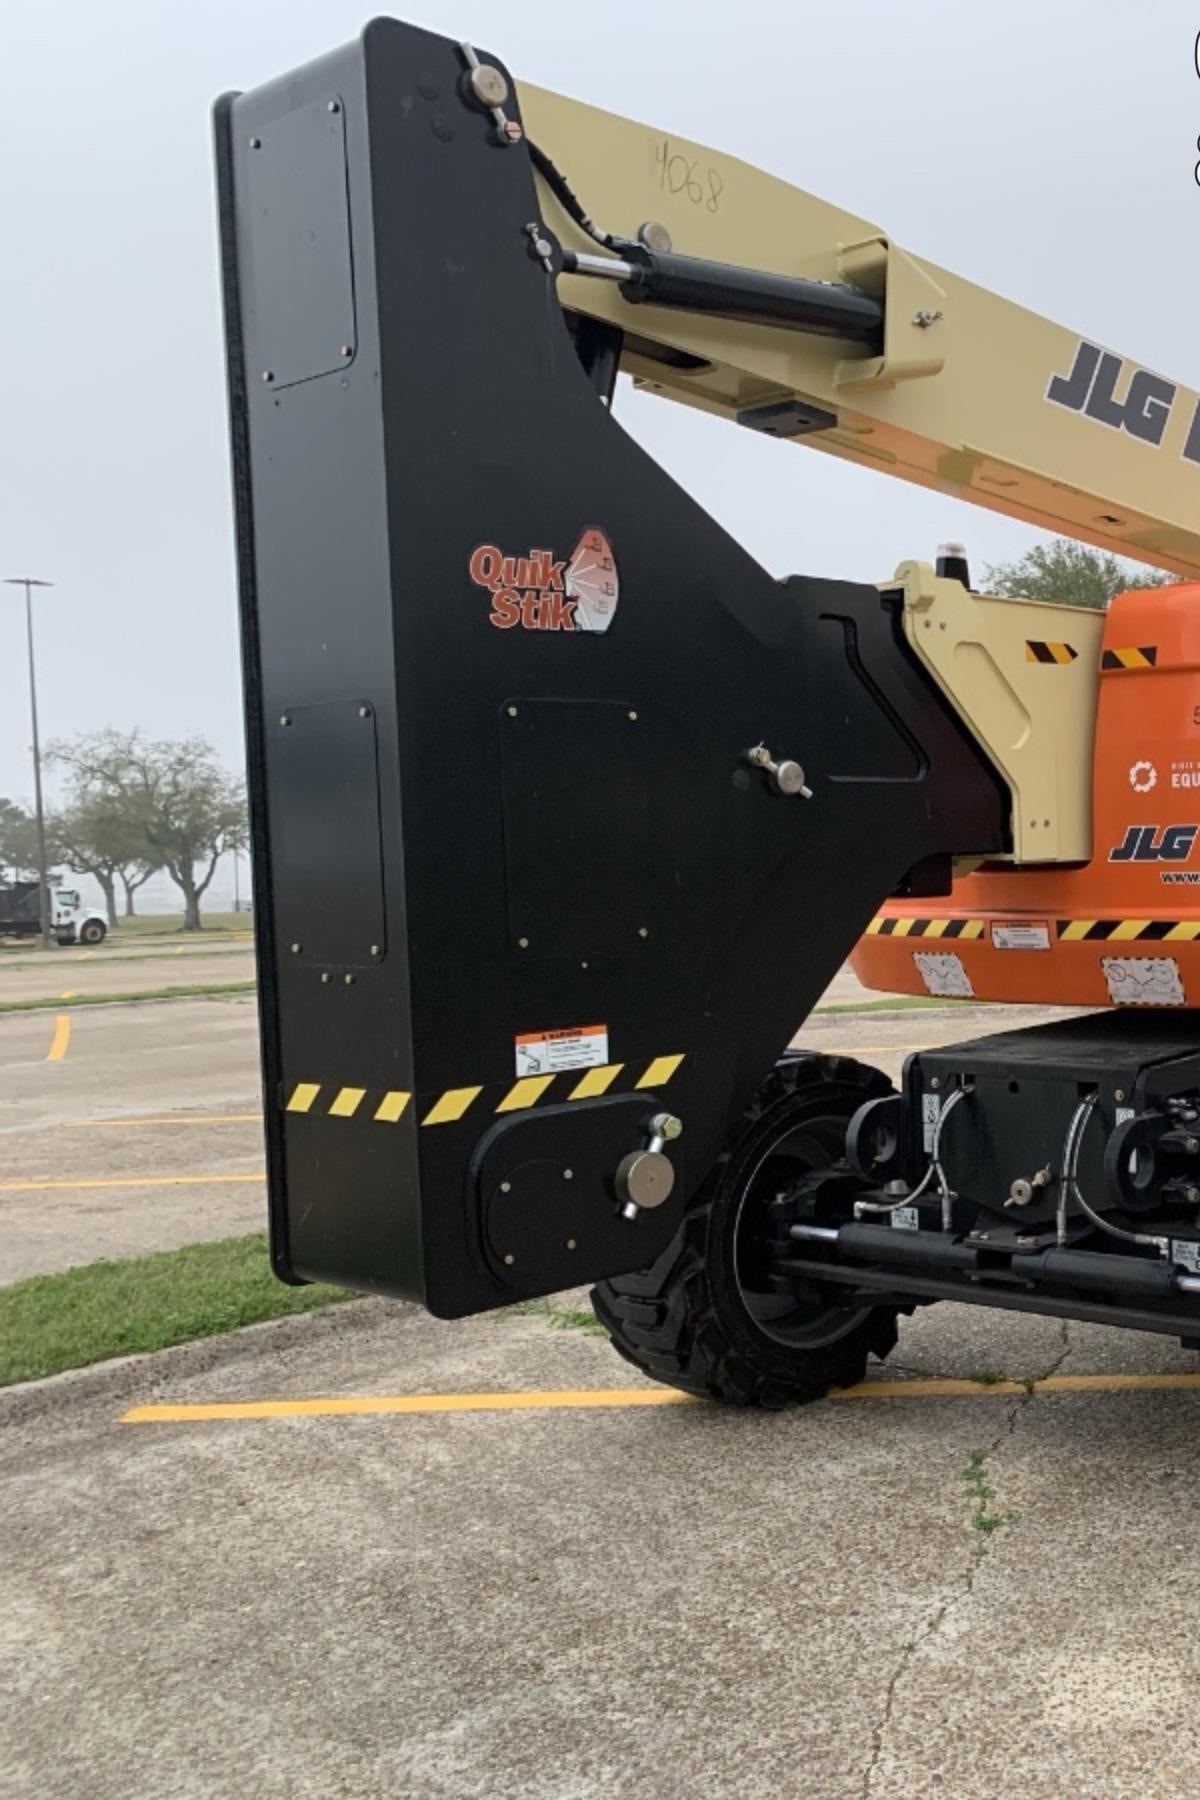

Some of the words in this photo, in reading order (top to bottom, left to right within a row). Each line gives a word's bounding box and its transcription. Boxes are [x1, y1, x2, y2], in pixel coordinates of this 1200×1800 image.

[655, 140, 724, 213] 4068
[1046, 338, 1178, 448] JLG
[469, 544, 567, 593] Quik
[489, 587, 577, 630] Stik
[1109, 824, 1200, 862] JLG
